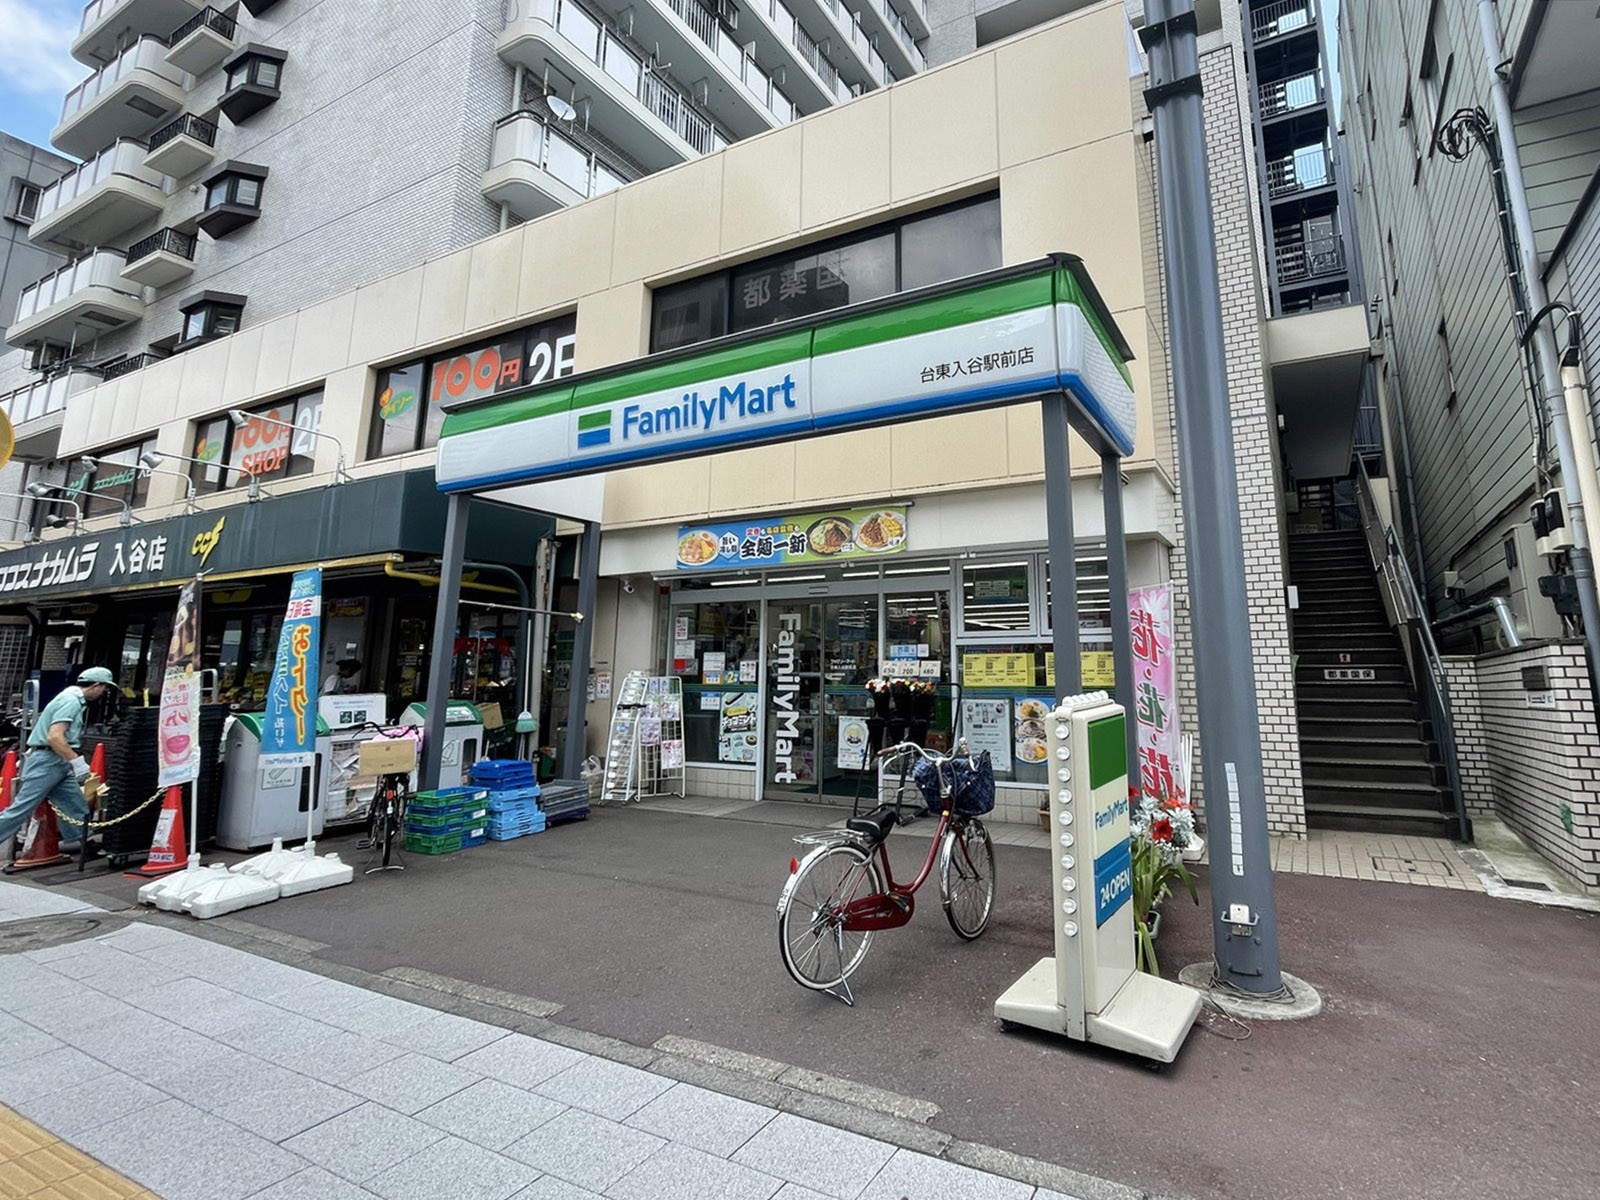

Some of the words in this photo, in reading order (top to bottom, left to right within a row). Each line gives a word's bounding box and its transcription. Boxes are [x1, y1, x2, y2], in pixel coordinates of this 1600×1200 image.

[919, 346, 1034, 383] 台東入谷駅前店
[623, 374, 796, 440] FamilyMart
[239, 445, 288, 477] SHOP
[109, 535, 167, 576] 入谷店
[740, 532, 807, 559] 全麺一新
[773, 613, 801, 784] FamilyMart
[1095, 797, 1128, 830] FamilyMart
